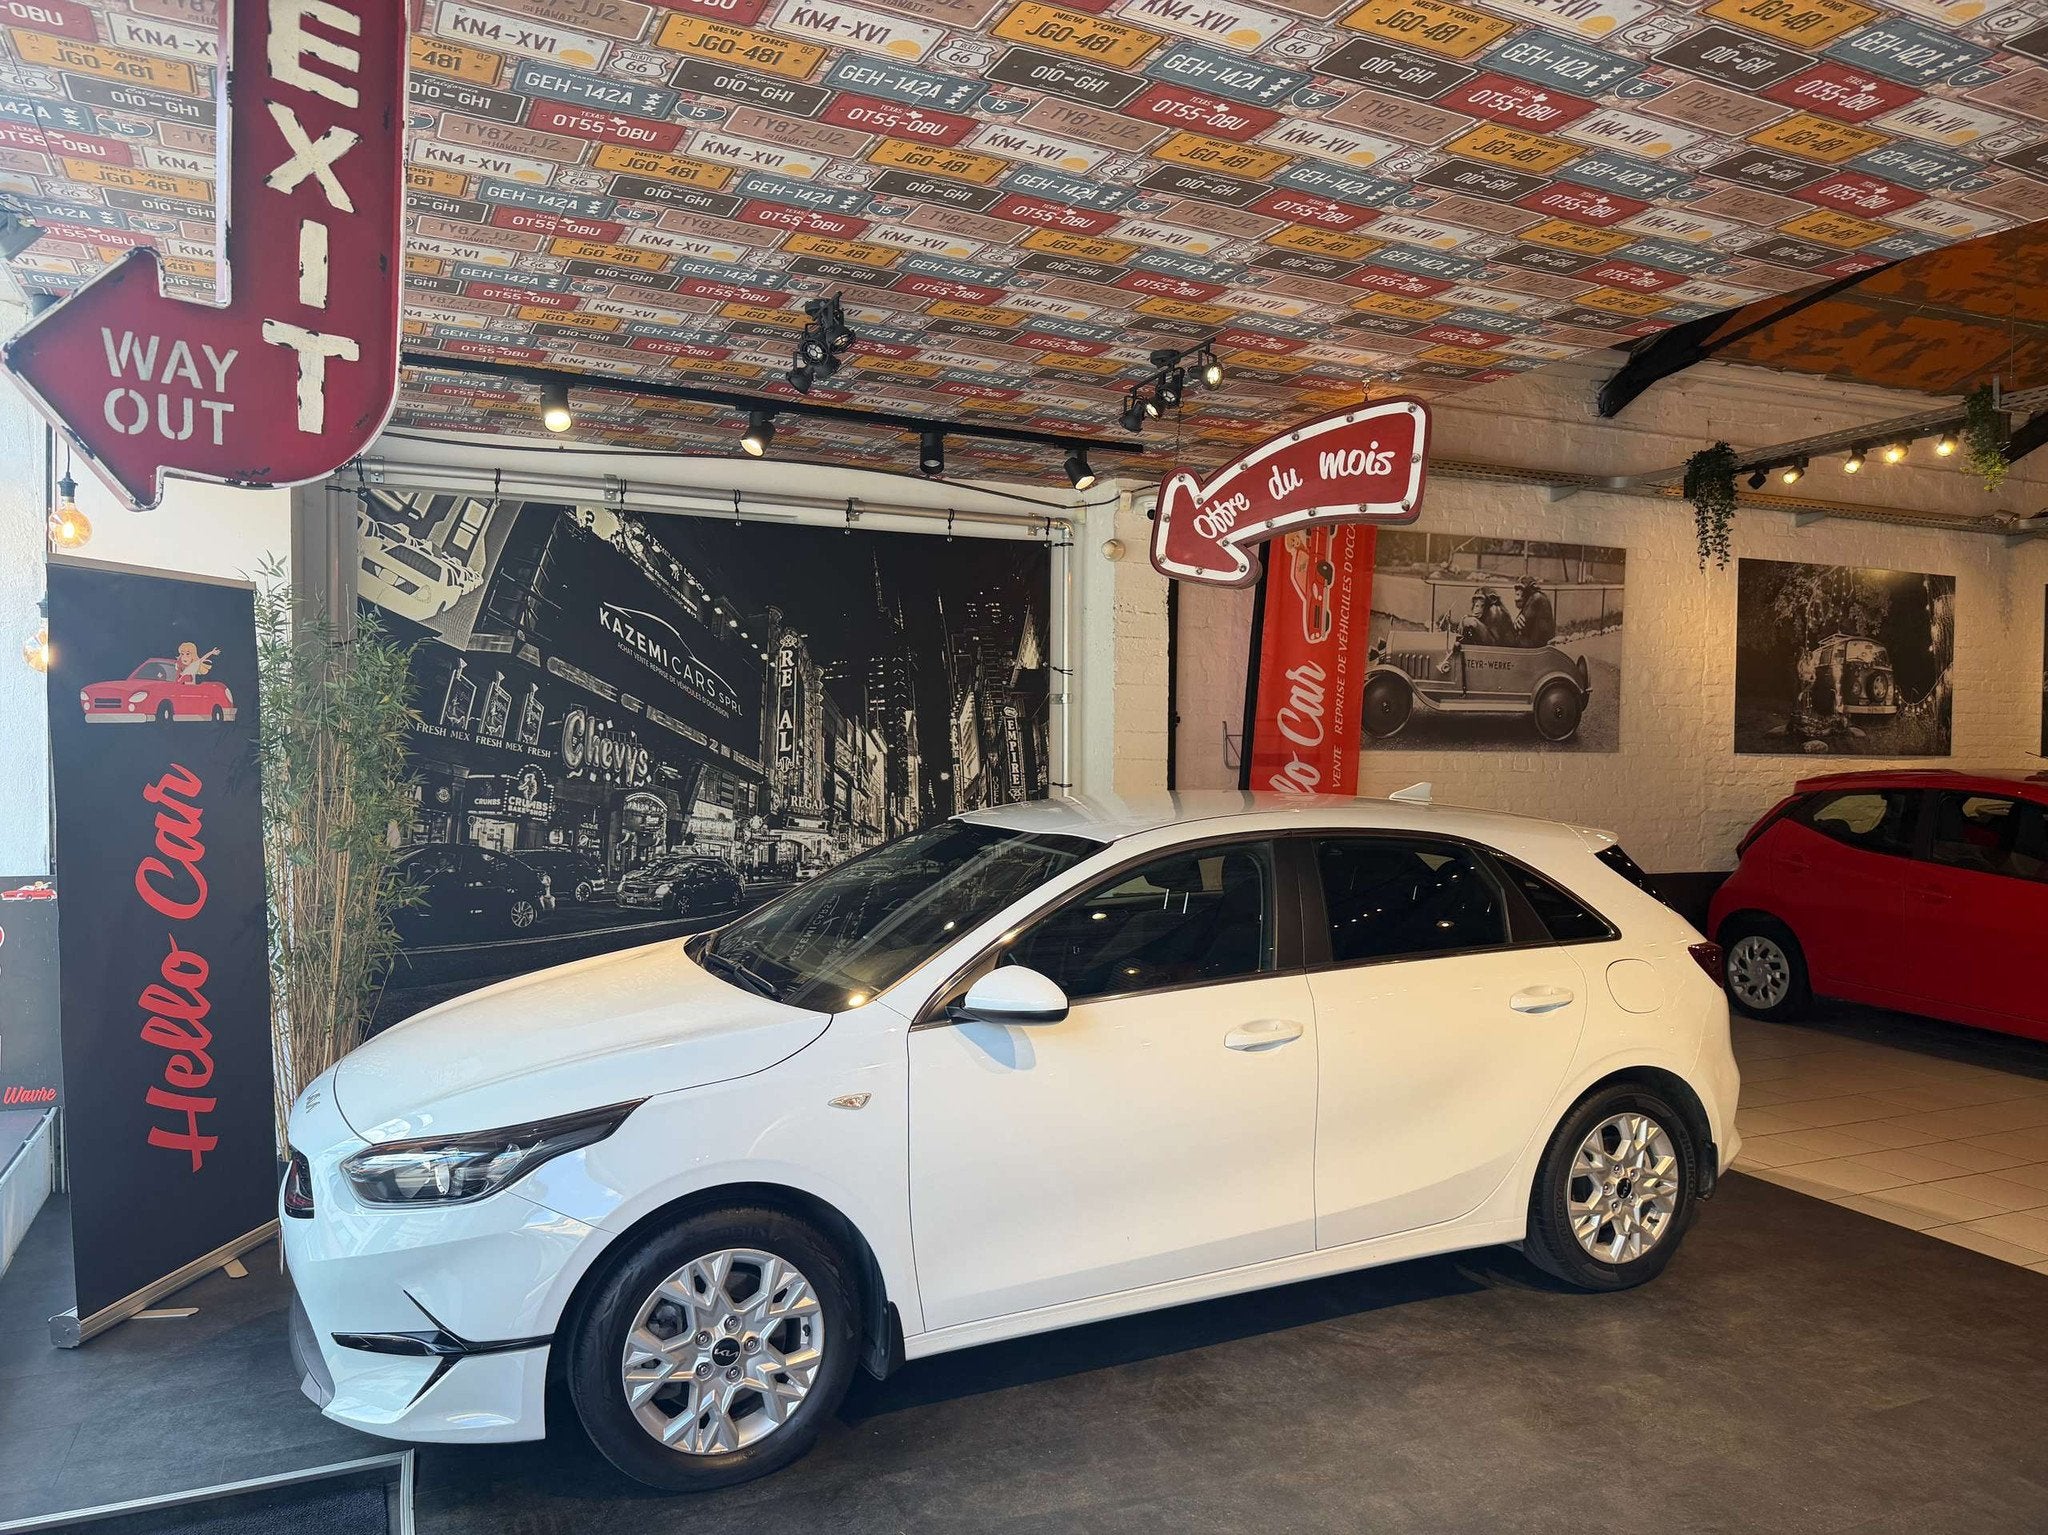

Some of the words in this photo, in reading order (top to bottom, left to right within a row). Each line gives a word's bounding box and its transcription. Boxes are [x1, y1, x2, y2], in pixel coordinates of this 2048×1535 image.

[1051, 12, 1088, 24] NEW
[1090, 20, 1131, 34] YORK
[1408, 1, 1446, 13] NEW
[1443, 10, 1485, 24] YORK
[1653, 19, 1681, 29] ROUTE
[707, 25, 743, 36] NEW
[748, 33, 790, 46] YORK
[957, 42, 982, 51] ROUTE
[1298, 32, 1325, 42] ROUTE
[1630, 30, 1662, 41] 66
[629, 52, 653, 61] ROUTE
[946, 52, 973, 63] 66
[1282, 42, 1311, 54] 66
[1846, 30, 1949, 69] GEH-142A
[624, 62, 649, 72] 66
[1497, 42, 1603, 79] GEH-142A
[10, 76, 36, 86] 66
[836, 64, 946, 99] GEH-142A
[1160, 54, 1268, 90] GEH-142A
[1839, 76, 1866, 86] TEXAS
[1956, 70, 1992, 82] 15
[524, 71, 635, 105] GEH-142A
[1299, 93, 1327, 104] 15
[1507, 87, 1534, 96] TEXAS
[1622, 82, 1654, 94] 15
[688, 106, 709, 117] 15
[878, 104, 904, 113] TEXAS
[988, 99, 1012, 110] 15
[1187, 97, 1213, 106] TEXAS
[1682, 152, 1710, 160] 66
[1863, 148, 1950, 176] GEH-142A
[1286, 169, 1376, 194] GEH-142A
[1570, 160, 1658, 186] GEH-142A
[745, 180, 837, 204] GEH-142A
[1011, 174, 1102, 199] GEH-142A
[486, 186, 580, 210] GEH-142A
[262, 0, 361, 434] EXIT
[1623, 244, 1698, 264] GEH-142A
[101, 326, 239, 393] WAY
[103, 387, 235, 446] OUT
[1193, 488, 1250, 541] Offre
[1267, 464, 1304, 501] du
[1319, 441, 1397, 480] mois
[599, 606, 669, 668] KAZEMI
[671, 656, 716, 698] CARS
[719, 692, 743, 717] SPRL
[634, 652, 650, 668] VENTE
[1337, 653, 1347, 676] DE
[1466, 659, 1515, 670] TEYR-WERKE-
[1277, 659, 1327, 747] Car
[1334, 677, 1346, 735] REPRISE
[416, 722, 447, 737] FRESH
[450, 730, 470, 742] MEX
[475, 735, 503, 748] FRESH
[505, 741, 524, 753] MEX
[527, 746, 551, 758] FRESH
[562, 709, 649, 788] Chevys
[1006, 719, 1021, 785] EMPIRE
[1332, 745, 1343, 788] VENTE
[474, 797, 501, 806] CRUMBS
[508, 795, 548, 811] CRUMBS
[134, 762, 209, 920] Car
[138, 932, 219, 1173] Hello
[3, 1086, 58, 1105] Wavre
